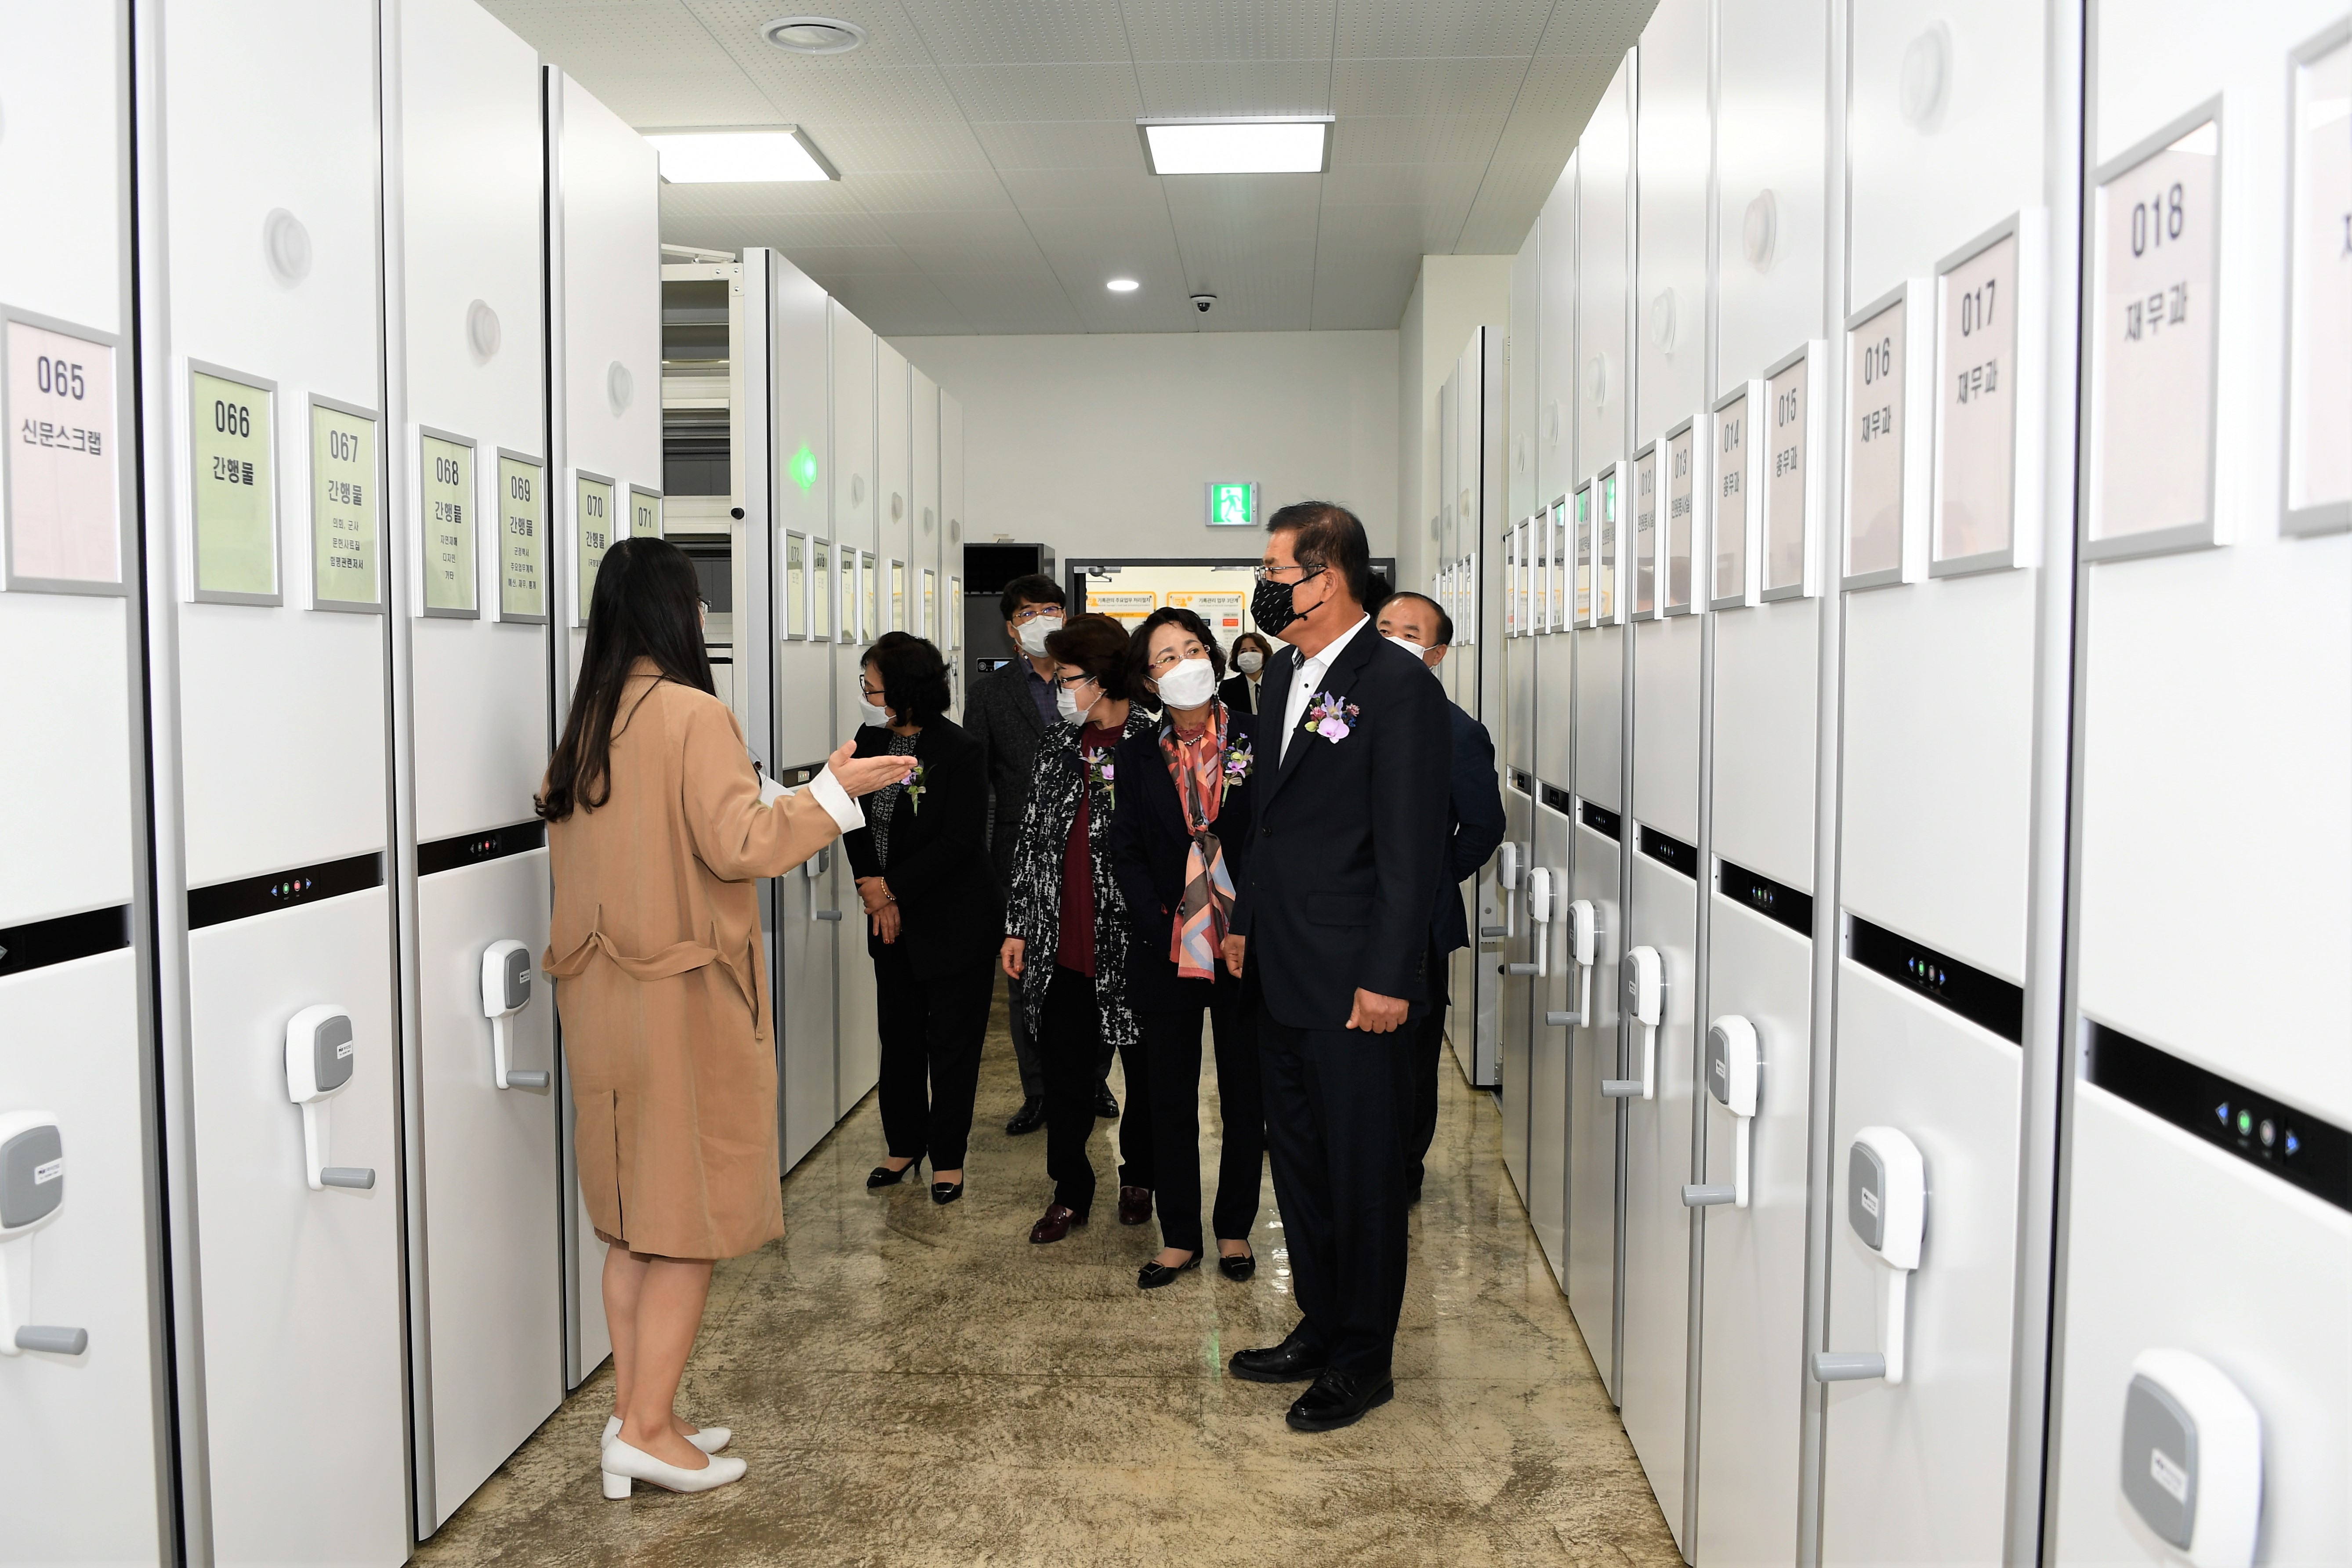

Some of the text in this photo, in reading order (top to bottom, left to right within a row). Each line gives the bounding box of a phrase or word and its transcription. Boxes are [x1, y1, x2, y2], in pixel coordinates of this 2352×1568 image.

[2132, 183, 2183, 258] 018
[1962, 279, 1996, 337] 017
[2125, 281, 2188, 342] 재무과
[1865, 337, 1890, 385] 016
[37, 356, 84, 401] 065
[1957, 359, 1997, 404] 재무과
[215, 400, 250, 438] 066
[1779, 387, 1797, 428] 015
[22, 419, 101, 456] 신문스크랩
[1724, 419, 1739, 453] 014
[1861, 405, 1891, 442] 재무과
[330, 430, 358, 463] 067
[1776, 445, 1798, 478] 총무과
[213, 456, 254, 486] 간행물
[436, 457, 459, 486] 068
[1675, 449, 1687, 479] 013
[328, 480, 362, 506] 간행물
[511, 475, 530, 502] 069
[1641, 469, 1651, 497] 012
[1723, 471, 1740, 498] 총무과
[435, 501, 462, 524] 간행물
[587, 494, 603, 518] 070
[638, 507, 651, 528] 071
[510, 516, 533, 537] 간행물
[586, 531, 605, 550] 간행물
[442, 553, 456, 563] 디자인
[791, 546, 800, 561] 072
[445, 571, 454, 580] 기타
